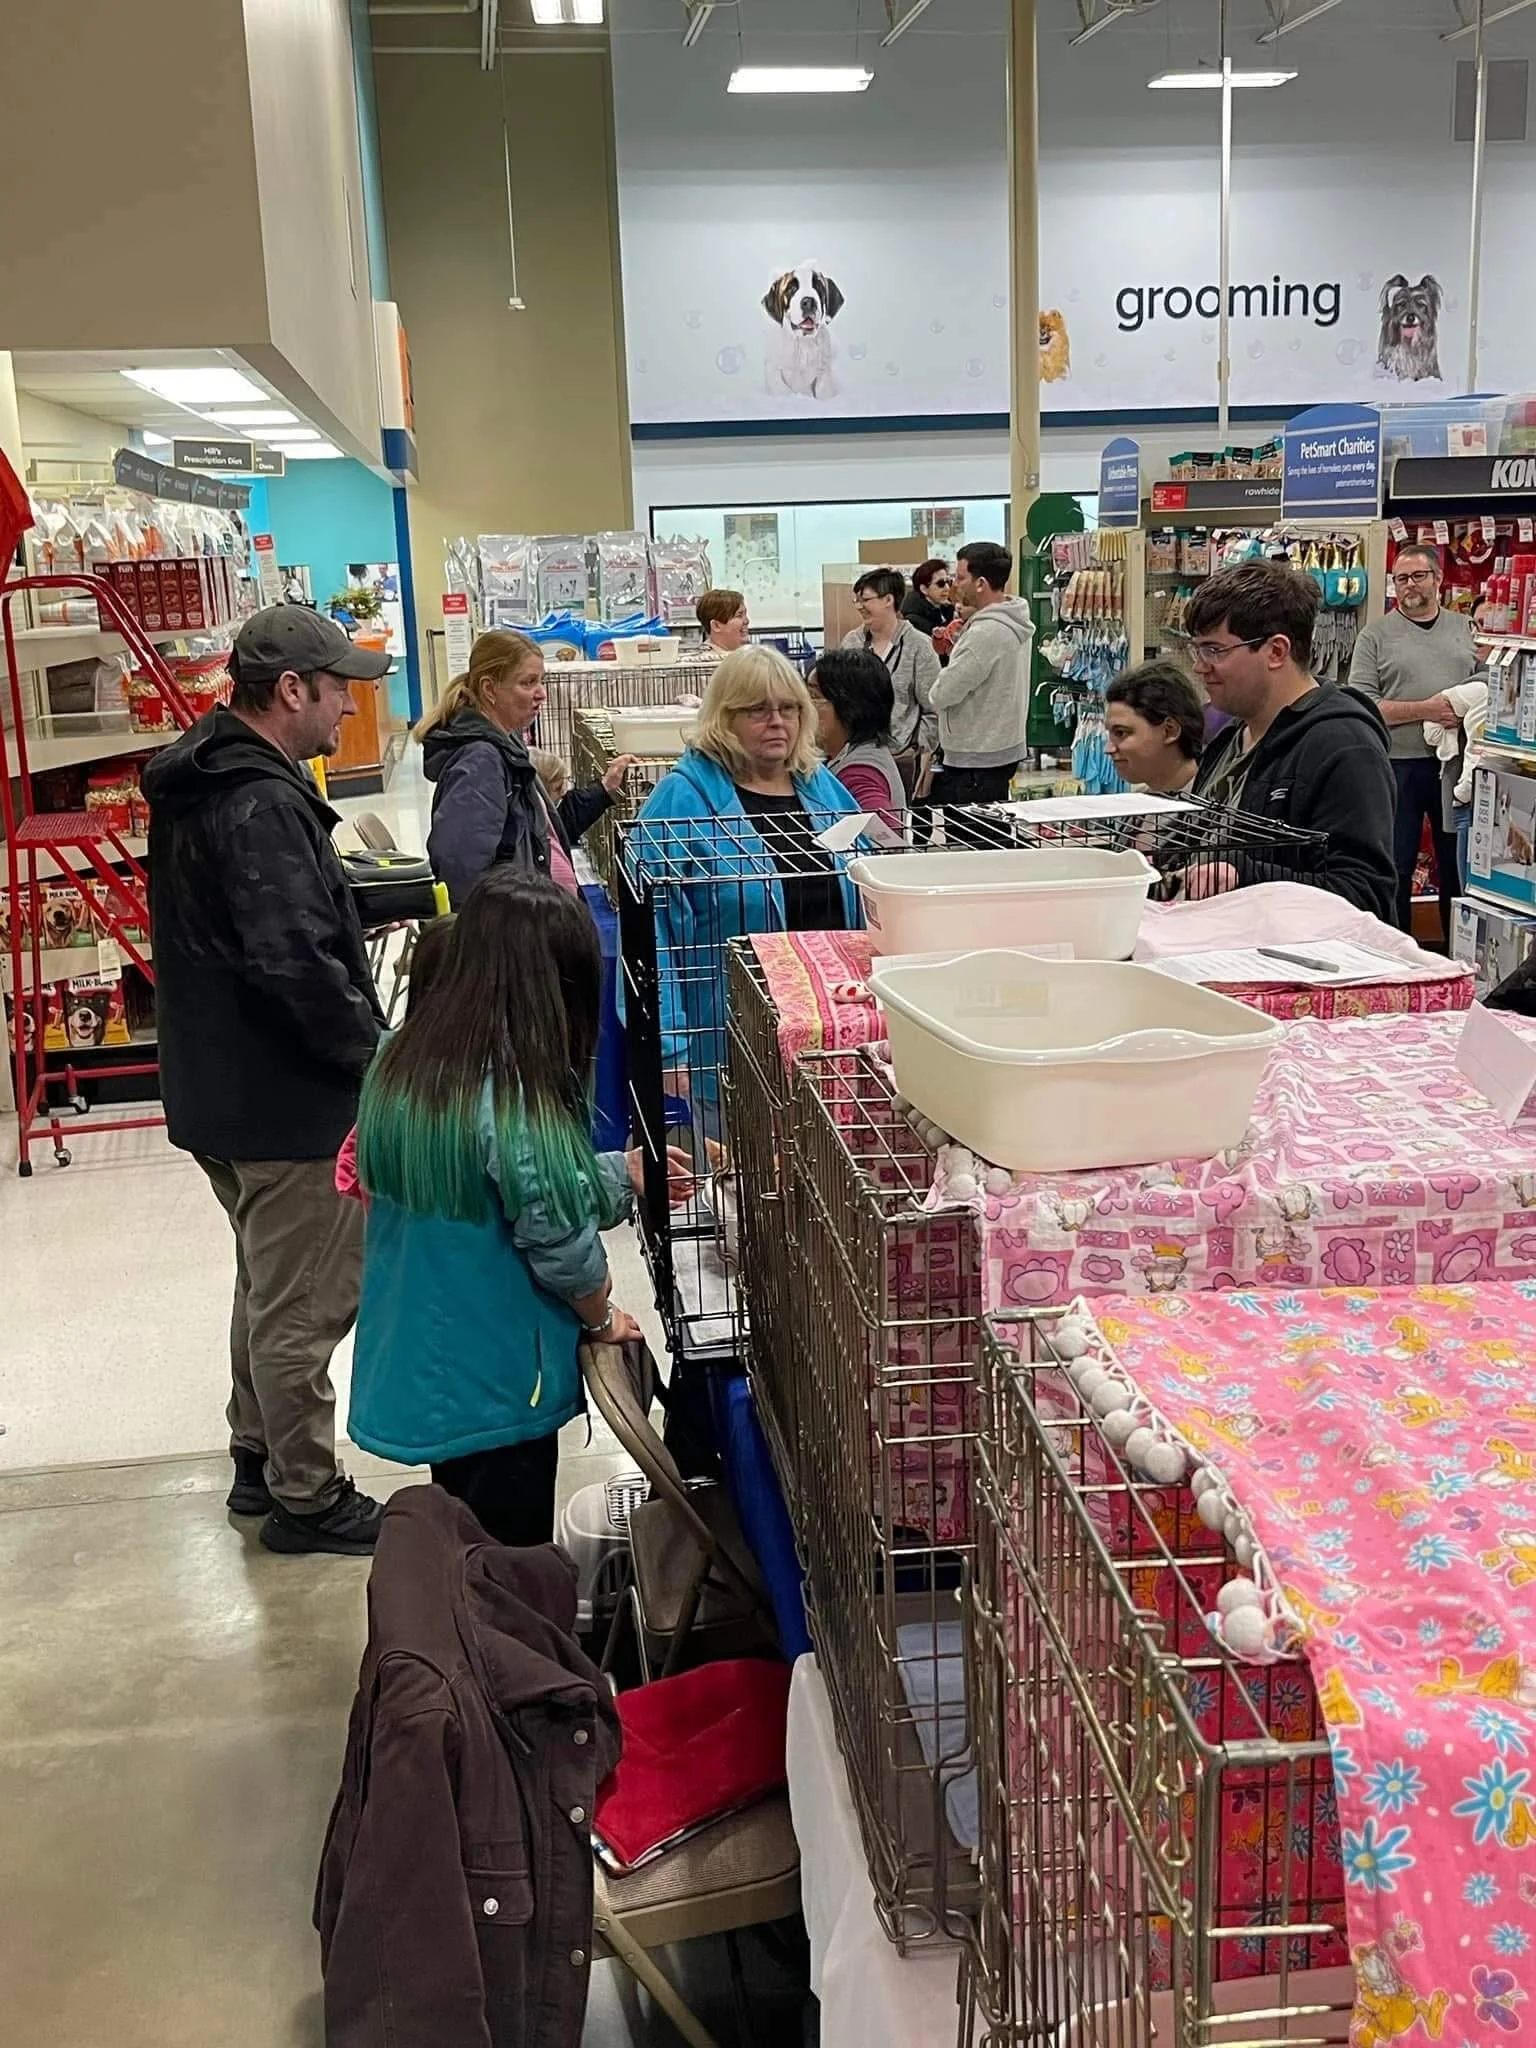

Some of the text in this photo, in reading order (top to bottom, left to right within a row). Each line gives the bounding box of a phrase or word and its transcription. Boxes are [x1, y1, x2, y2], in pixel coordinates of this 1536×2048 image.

[1116, 275, 1341, 332] grooming
[1300, 436, 1375, 459] PetSmart Charities
[183, 455, 243, 465] Prescription Diet
[1352, 462, 1365, 473] every
[1244, 488, 1280, 496] rawhide
